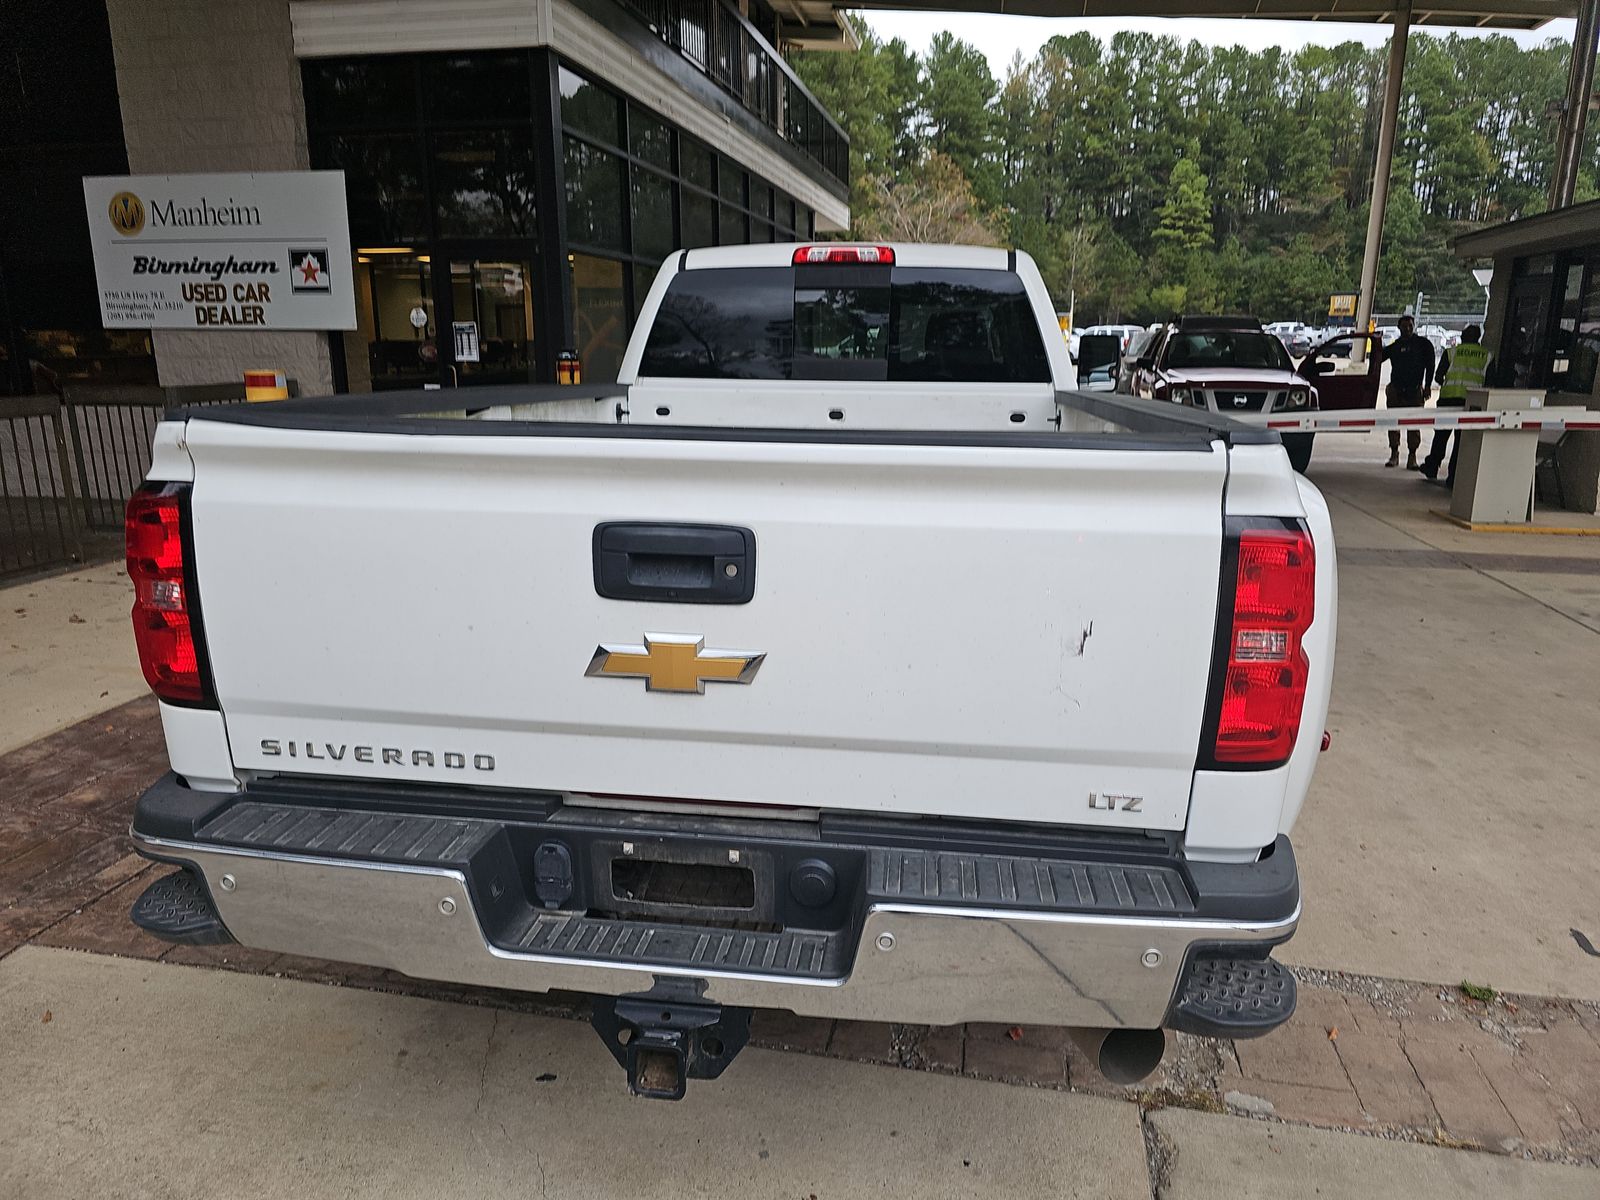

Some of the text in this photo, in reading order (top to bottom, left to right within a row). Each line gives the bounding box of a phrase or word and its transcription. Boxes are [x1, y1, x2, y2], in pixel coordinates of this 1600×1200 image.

[150, 197, 262, 227] Manheim
[132, 253, 280, 281] Birmingham
[132, 290, 148, 301] Hwy
[181, 281, 272, 303] USED CAR
[195, 304, 266, 326] DEALER
[1456, 349, 1487, 358] SECURITY
[260, 738, 496, 771] SILVERADO
[1088, 791, 1144, 813] LTZ
